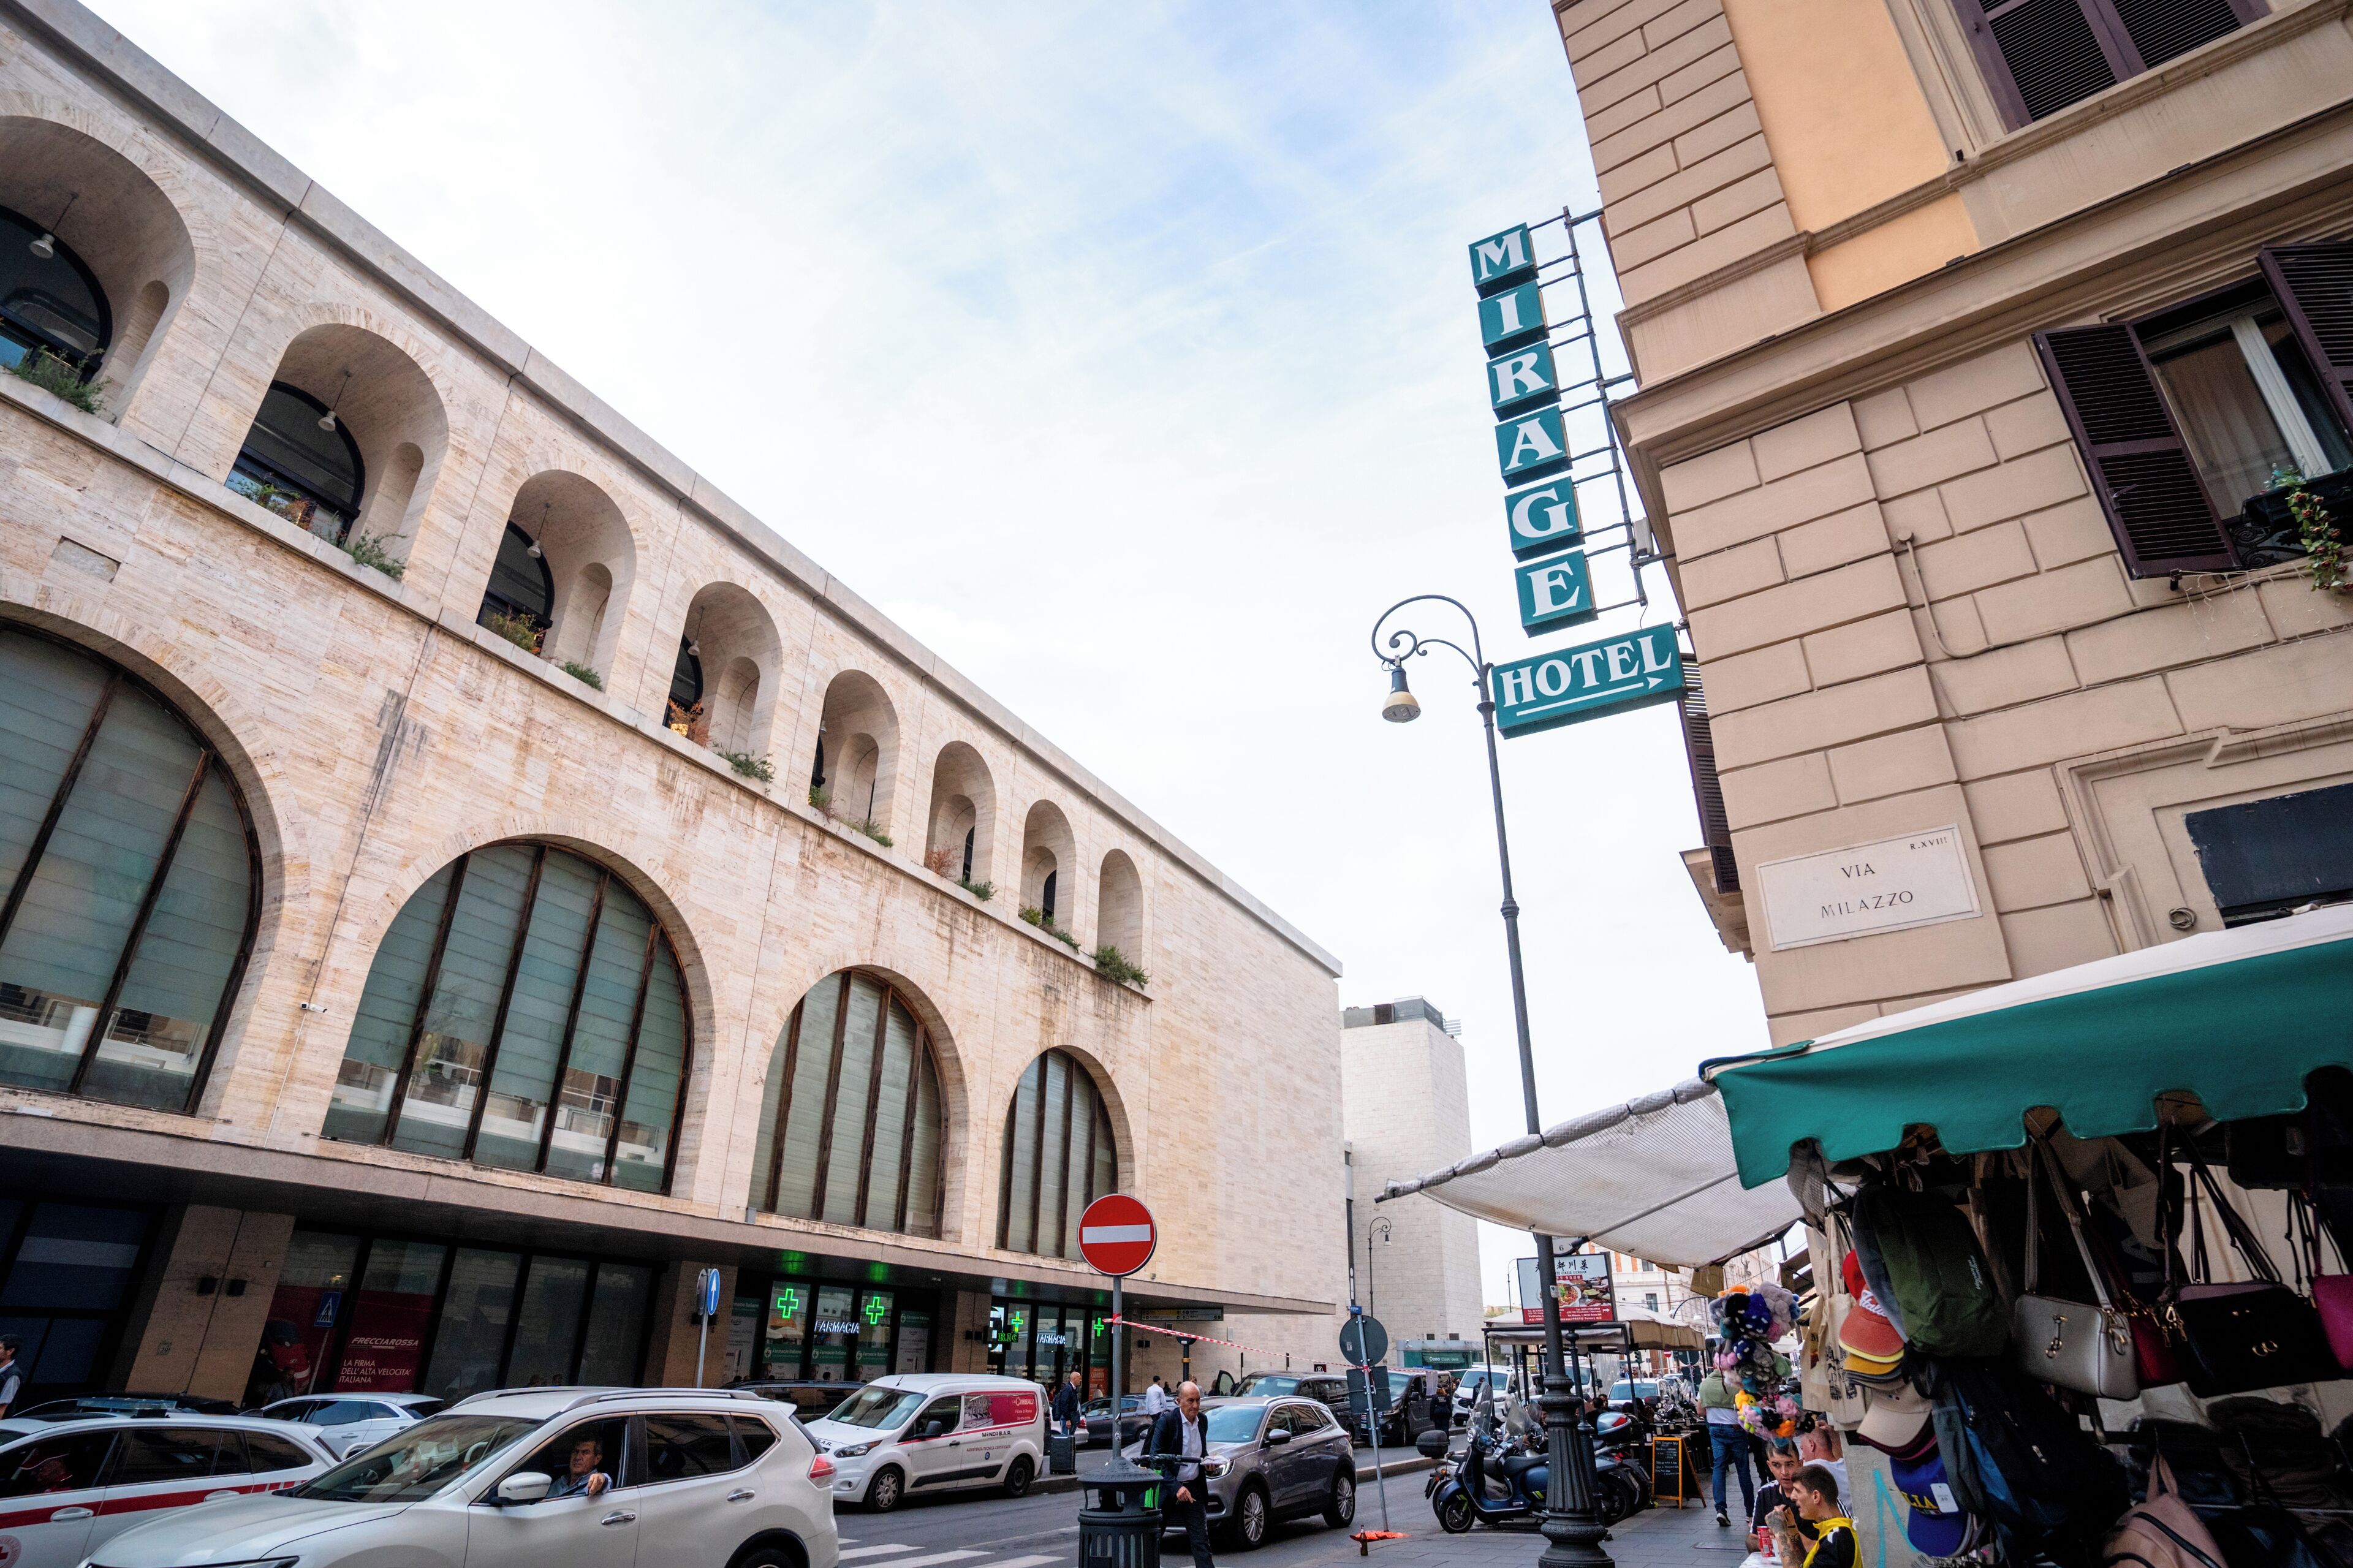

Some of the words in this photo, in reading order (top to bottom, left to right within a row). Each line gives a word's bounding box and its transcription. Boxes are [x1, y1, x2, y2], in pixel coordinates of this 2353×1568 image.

[1474, 229, 1580, 617] MIRAGE
[1499, 635, 1672, 708] HOTEL
[1841, 863, 1876, 879] VIA
[1821, 890, 1913, 918] MILAZZO
[814, 1320, 860, 1334] FARMACIA
[351, 1337, 419, 1347] FRECCIAROSSA
[1036, 1334, 1066, 1344] FARMACIA
